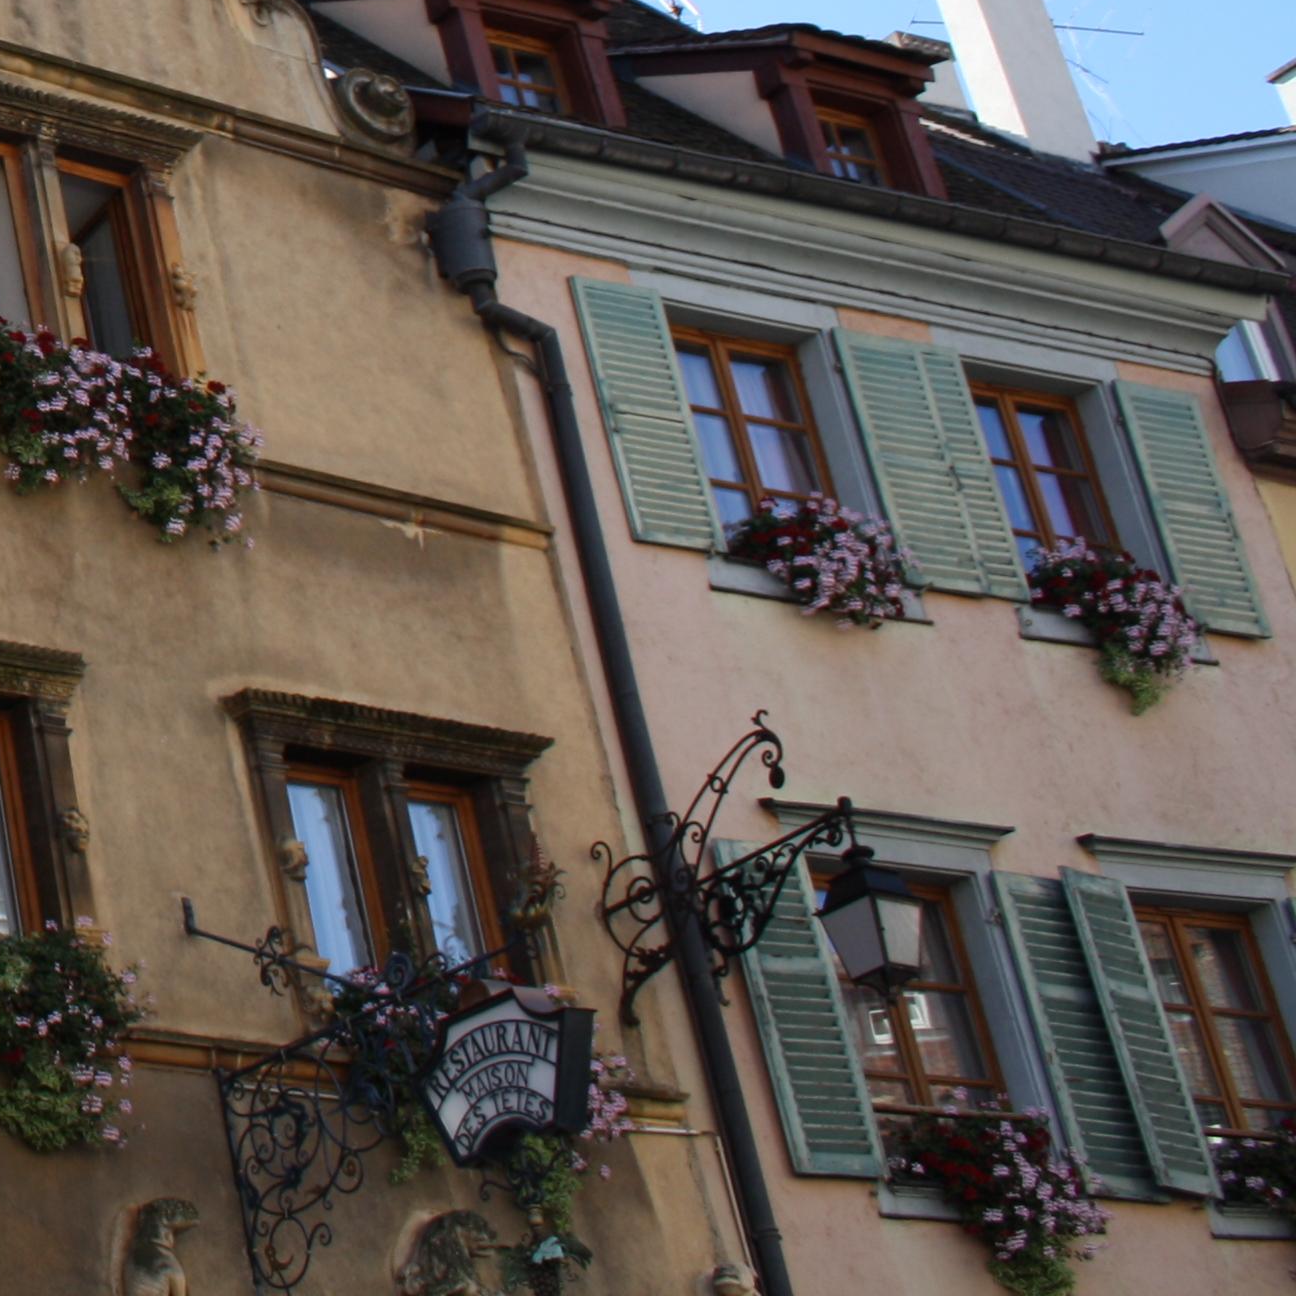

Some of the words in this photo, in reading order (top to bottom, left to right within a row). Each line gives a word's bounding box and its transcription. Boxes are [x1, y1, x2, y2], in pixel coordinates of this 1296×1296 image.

[428, 1021, 555, 1099] RESTAURANT
[460, 1063, 529, 1104] MAISON
[457, 1106, 486, 1152] DES
